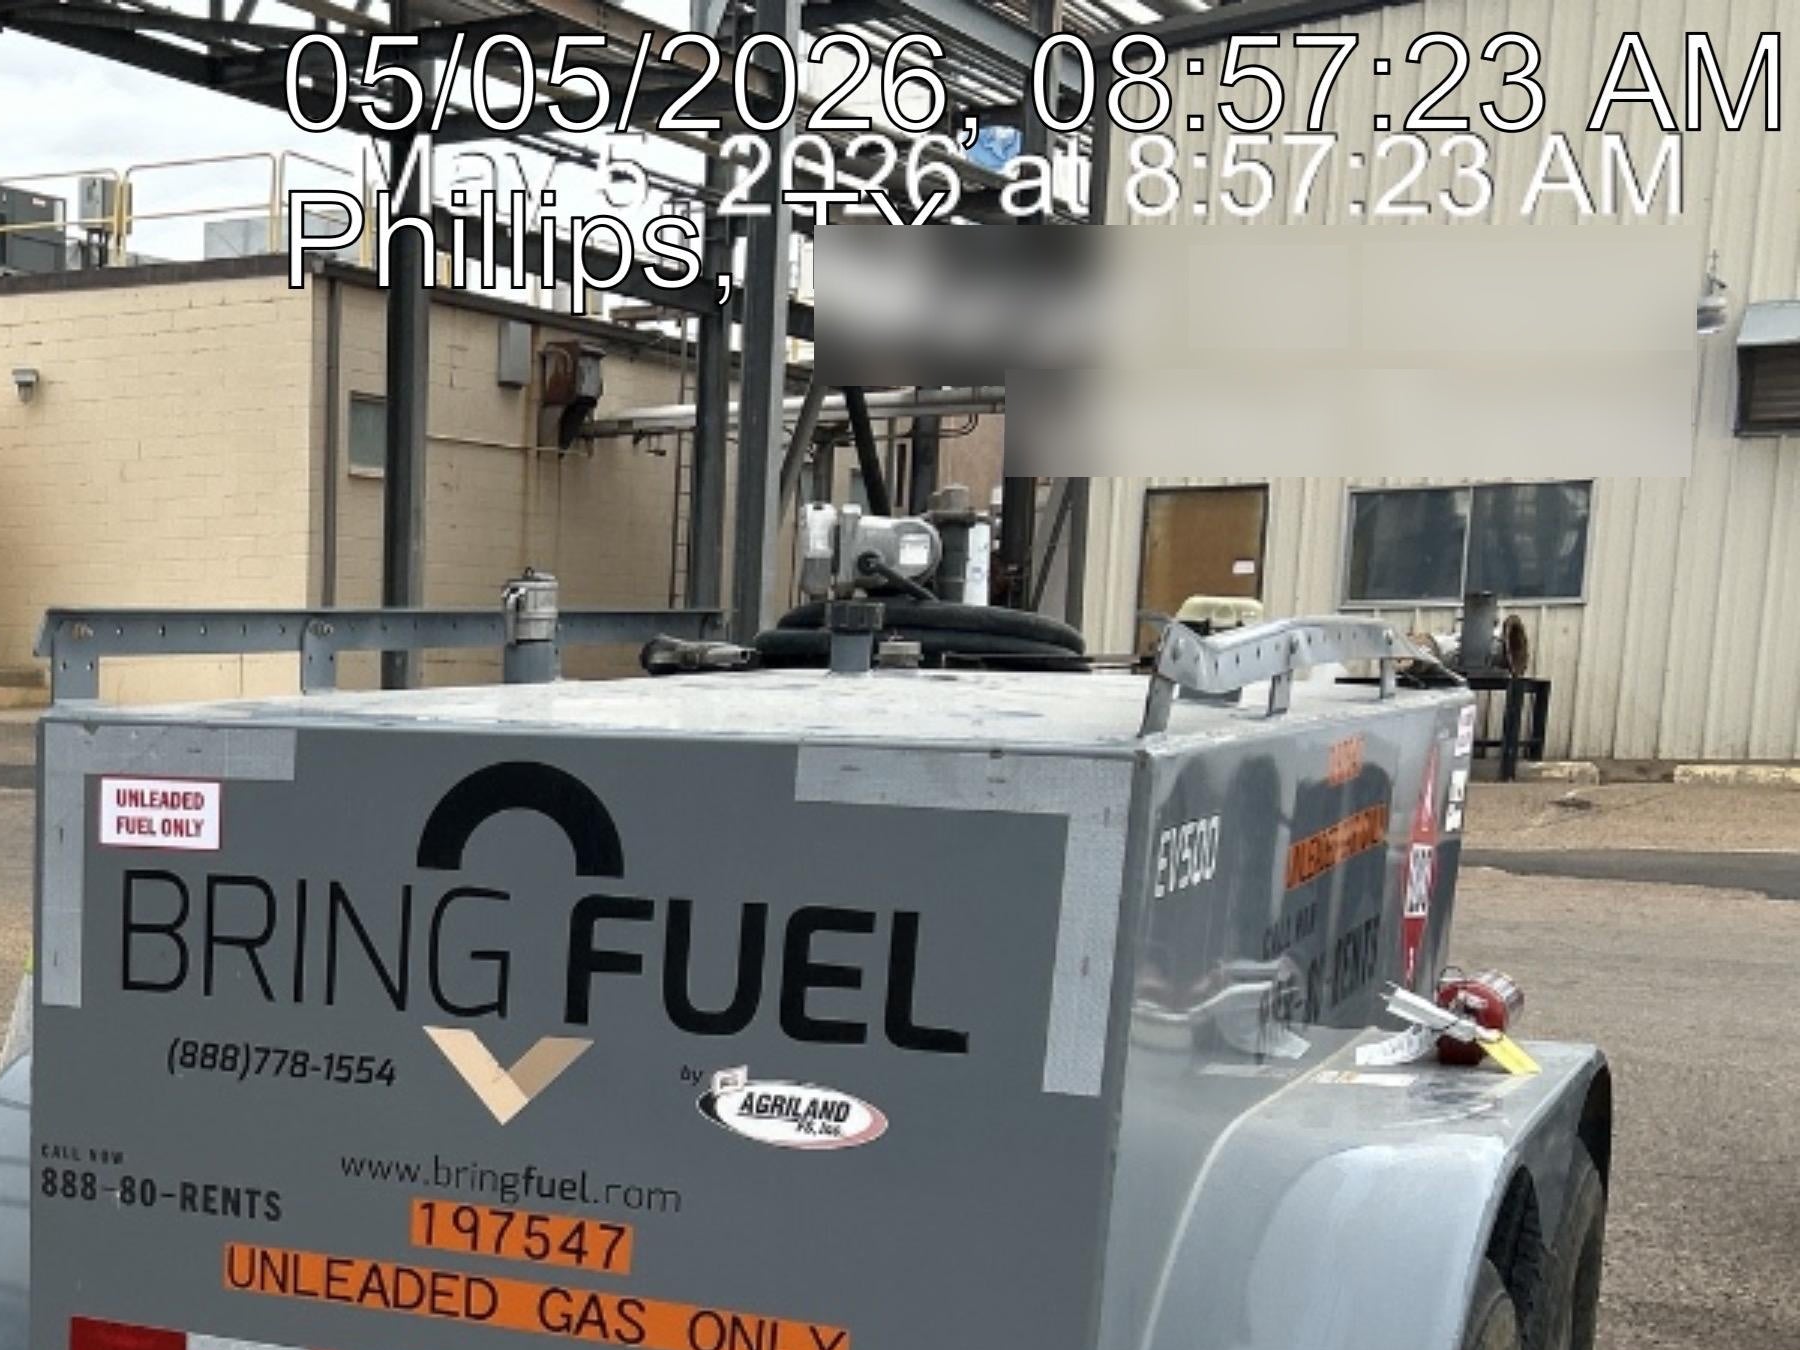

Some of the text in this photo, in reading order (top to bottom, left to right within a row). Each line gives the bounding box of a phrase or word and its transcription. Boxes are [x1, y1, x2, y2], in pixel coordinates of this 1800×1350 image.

[116, 788, 205, 811] UNLEADED
[116, 816, 204, 837] FUEL ONLY
[121, 868, 970, 1054] BRING FUEL
[167, 1037, 396, 1087] (888)778-1554
[740, 1092, 851, 1124] AGRILAND
[40, 1166, 282, 1223] 888-80-RENTS
[420, 1202, 626, 1270] 197547
[227, 1245, 499, 1321] UNLEADED
[537, 1287, 646, 1345] GAS
